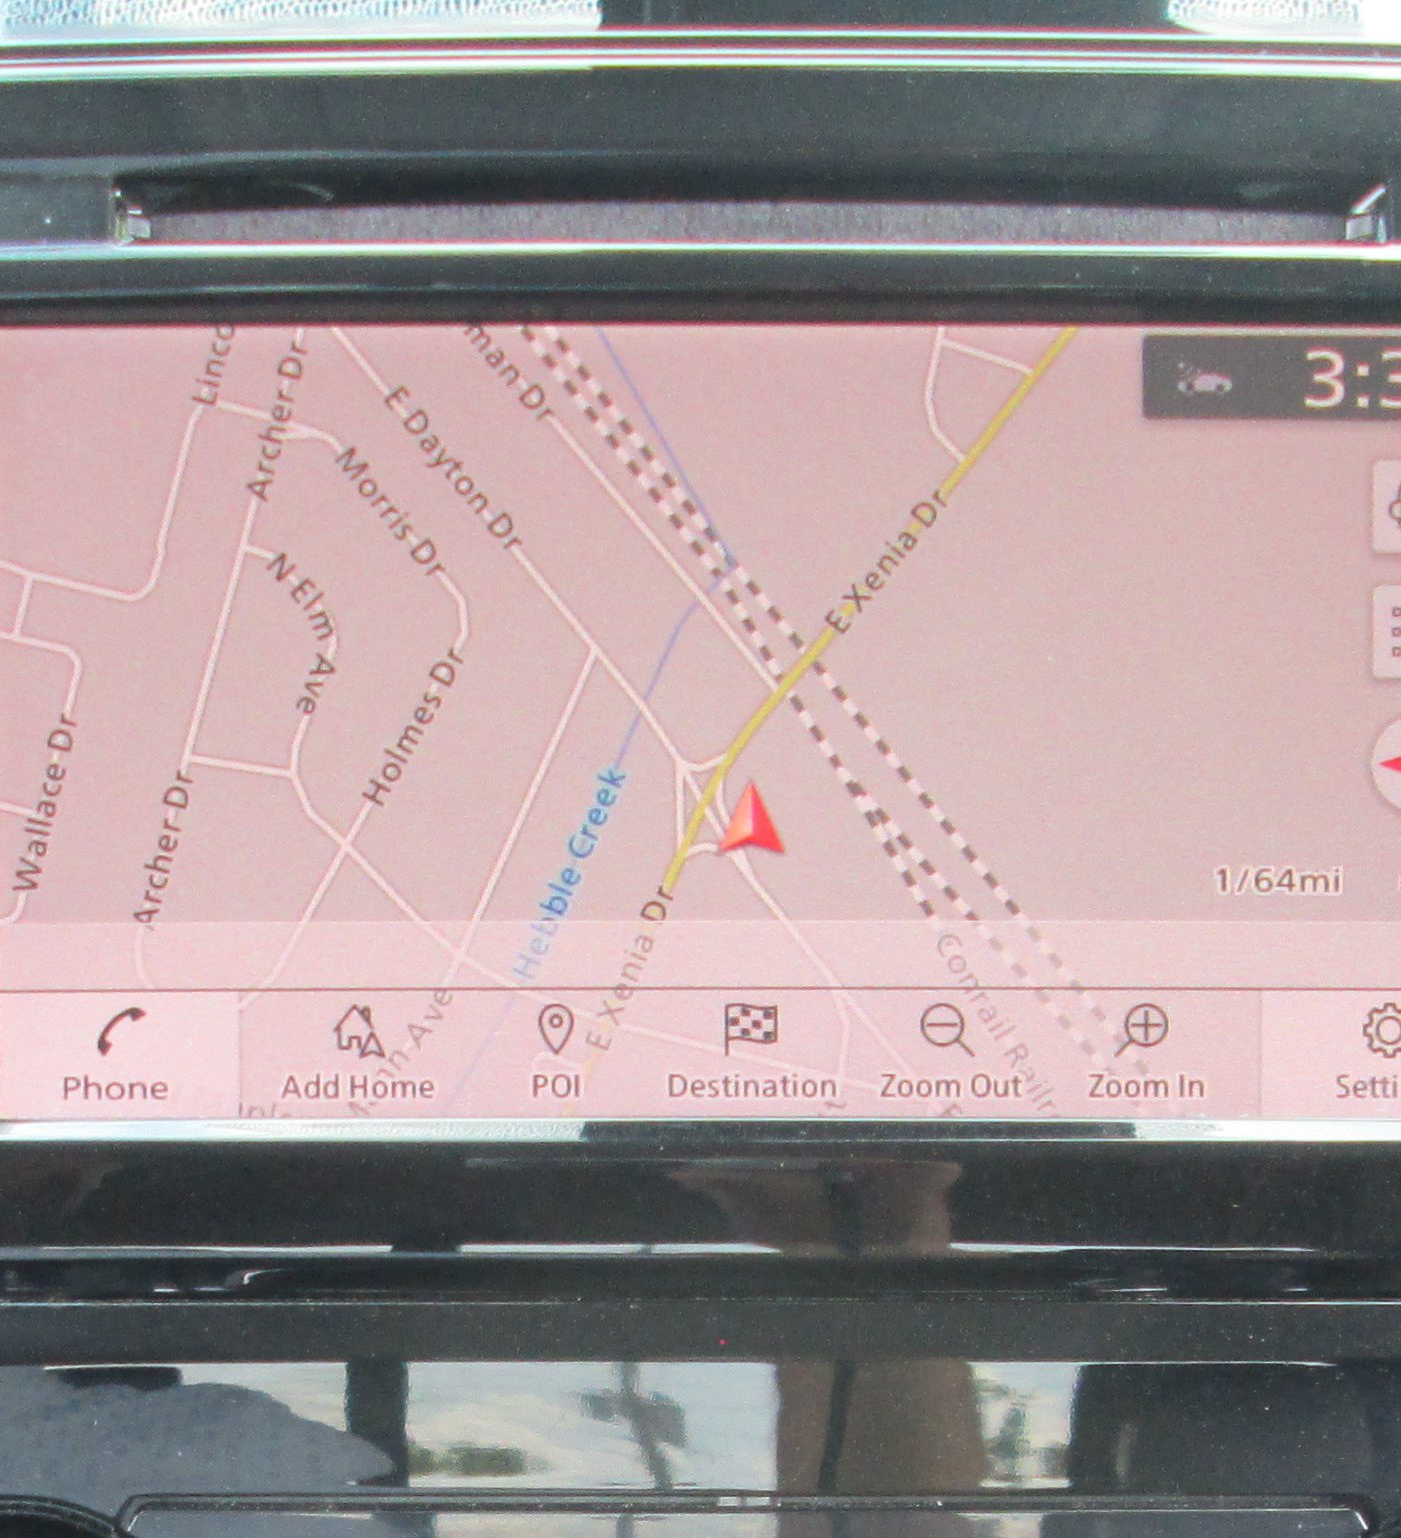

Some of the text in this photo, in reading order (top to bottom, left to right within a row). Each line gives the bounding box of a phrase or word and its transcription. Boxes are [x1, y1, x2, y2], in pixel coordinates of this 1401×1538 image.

[247, 341, 307, 501] Archer Dr
[519, 383, 554, 421] Dr
[336, 447, 446, 576] Morris Dr
[386, 386, 522, 549] E Dayton Dr
[825, 490, 947, 634] E Xenia Dr
[266, 553, 336, 714] N Elm Ave
[362, 648, 463, 806] Holmes Dr
[12, 713, 77, 892] Wallace Dr
[133, 770, 193, 930] Archer Dr
[513, 769, 626, 979] Hebble Creek
[1215, 866, 1343, 895] 1/64mi
[596, 934, 654, 1026] Xenia
[640, 885, 673, 924] Dr
[936, 933, 1016, 1041] Conrail
[62, 1075, 169, 1100] Phone
[281, 1074, 435, 1099] Add Home
[532, 1075, 581, 1099] POI
[667, 1073, 838, 1098] Destination
[881, 1073, 1022, 1098] Zoom Out
[1089, 1074, 1205, 1098] Zoom In
